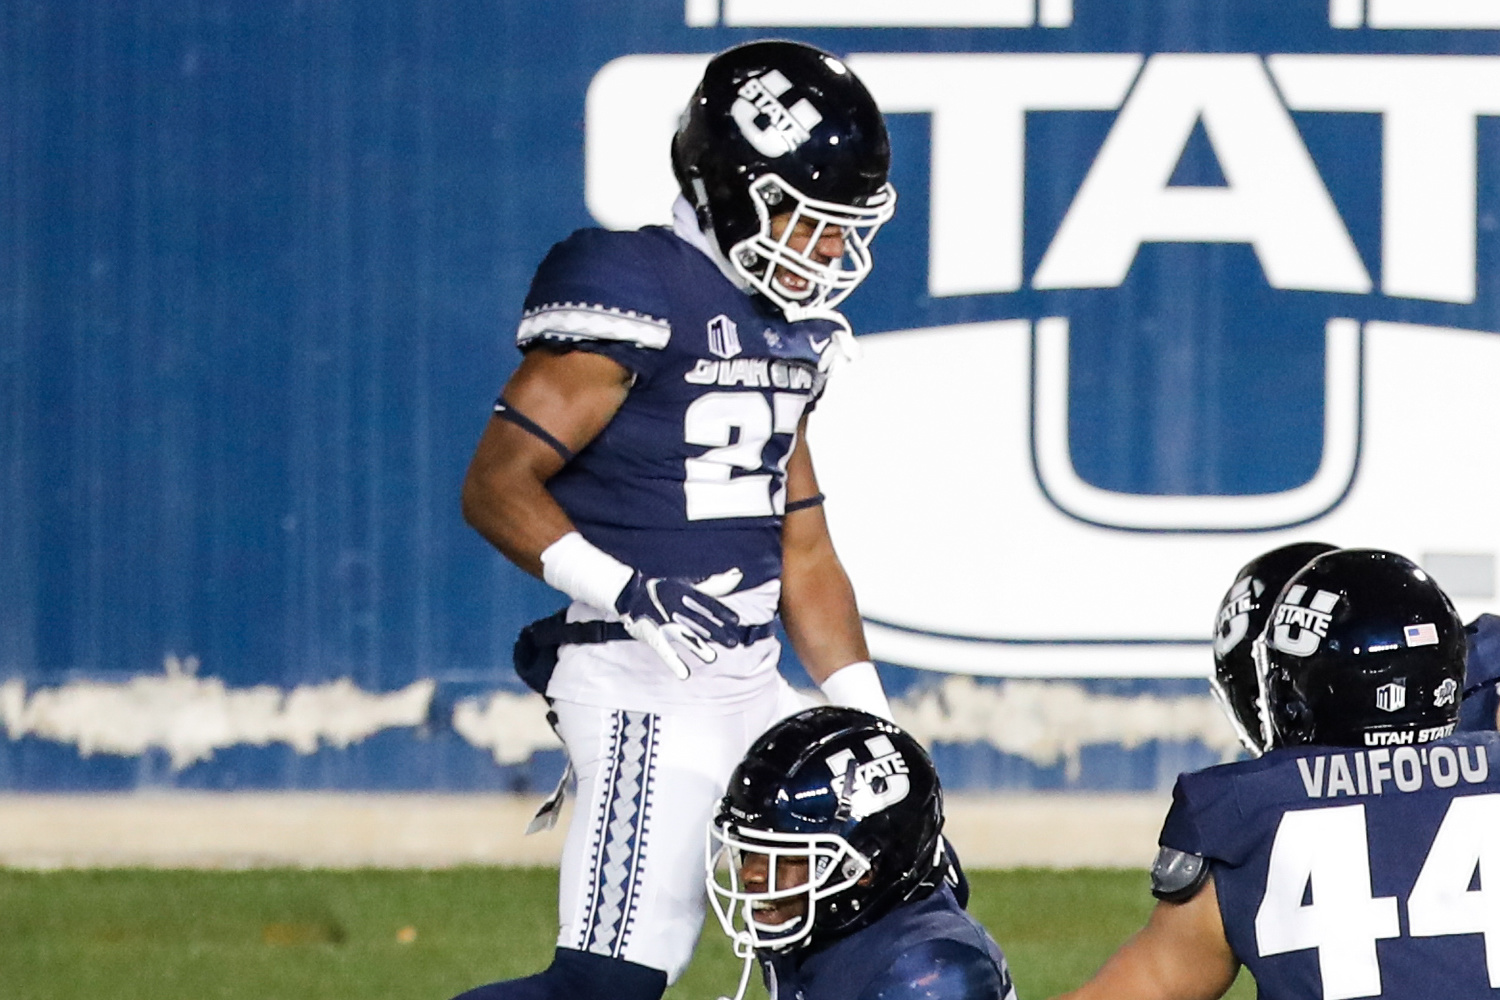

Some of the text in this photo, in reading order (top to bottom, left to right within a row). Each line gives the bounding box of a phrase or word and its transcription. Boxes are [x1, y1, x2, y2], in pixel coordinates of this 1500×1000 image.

[1274, 603, 1333, 638] STATE
[1364, 731, 1414, 746] UTAH
[1297, 746, 1489, 798] VAIFO'OU
